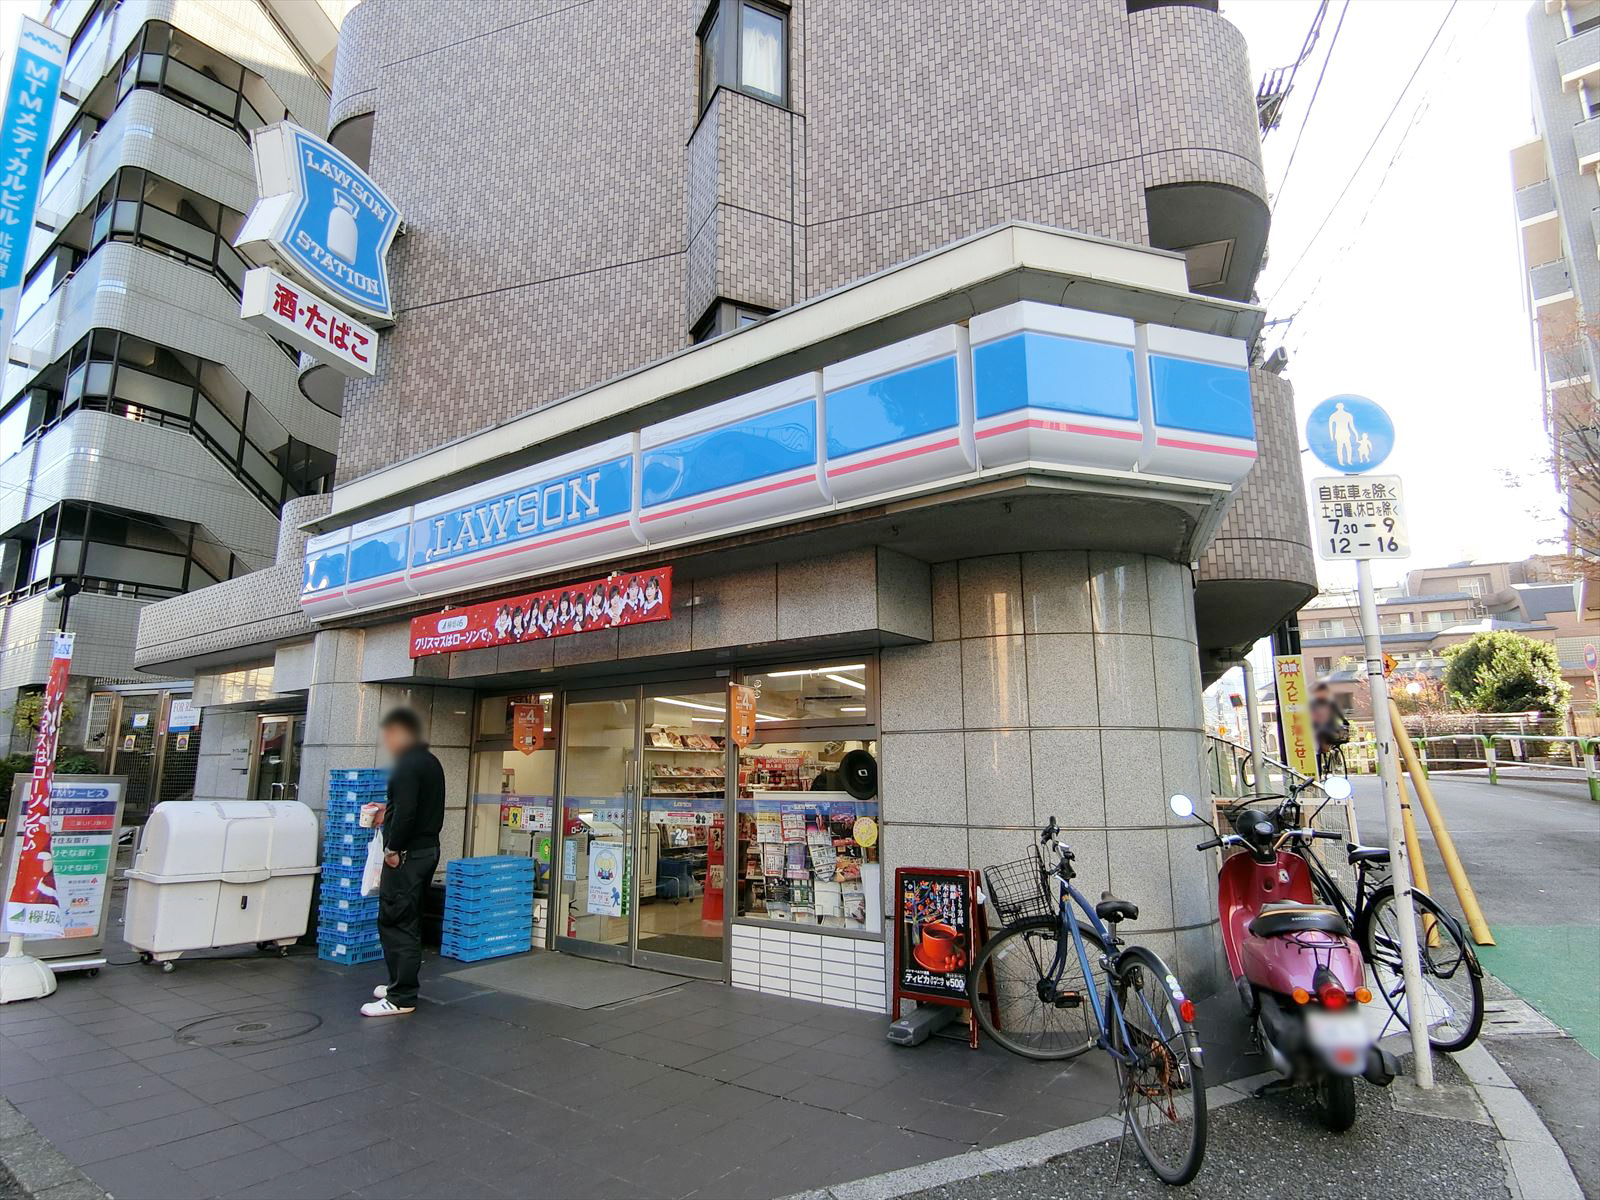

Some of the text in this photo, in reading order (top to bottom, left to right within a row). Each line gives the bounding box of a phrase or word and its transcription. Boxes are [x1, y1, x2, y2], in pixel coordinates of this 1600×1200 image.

[305, 149, 388, 223] LAWSON
[296, 229, 380, 296] STATION
[272, 282, 369, 363] 酒・たばこ
[433, 472, 600, 556] LAWSON
[1319, 483, 1397, 501] 自転車を除く
[1329, 537, 1351, 554] 12
[1377, 536, 1399, 552] 16
[1286, 681, 1306, 770] スピドとせ!
[52, 789, 106, 799] TMサービス
[905, 973, 930, 985] ティピカ
